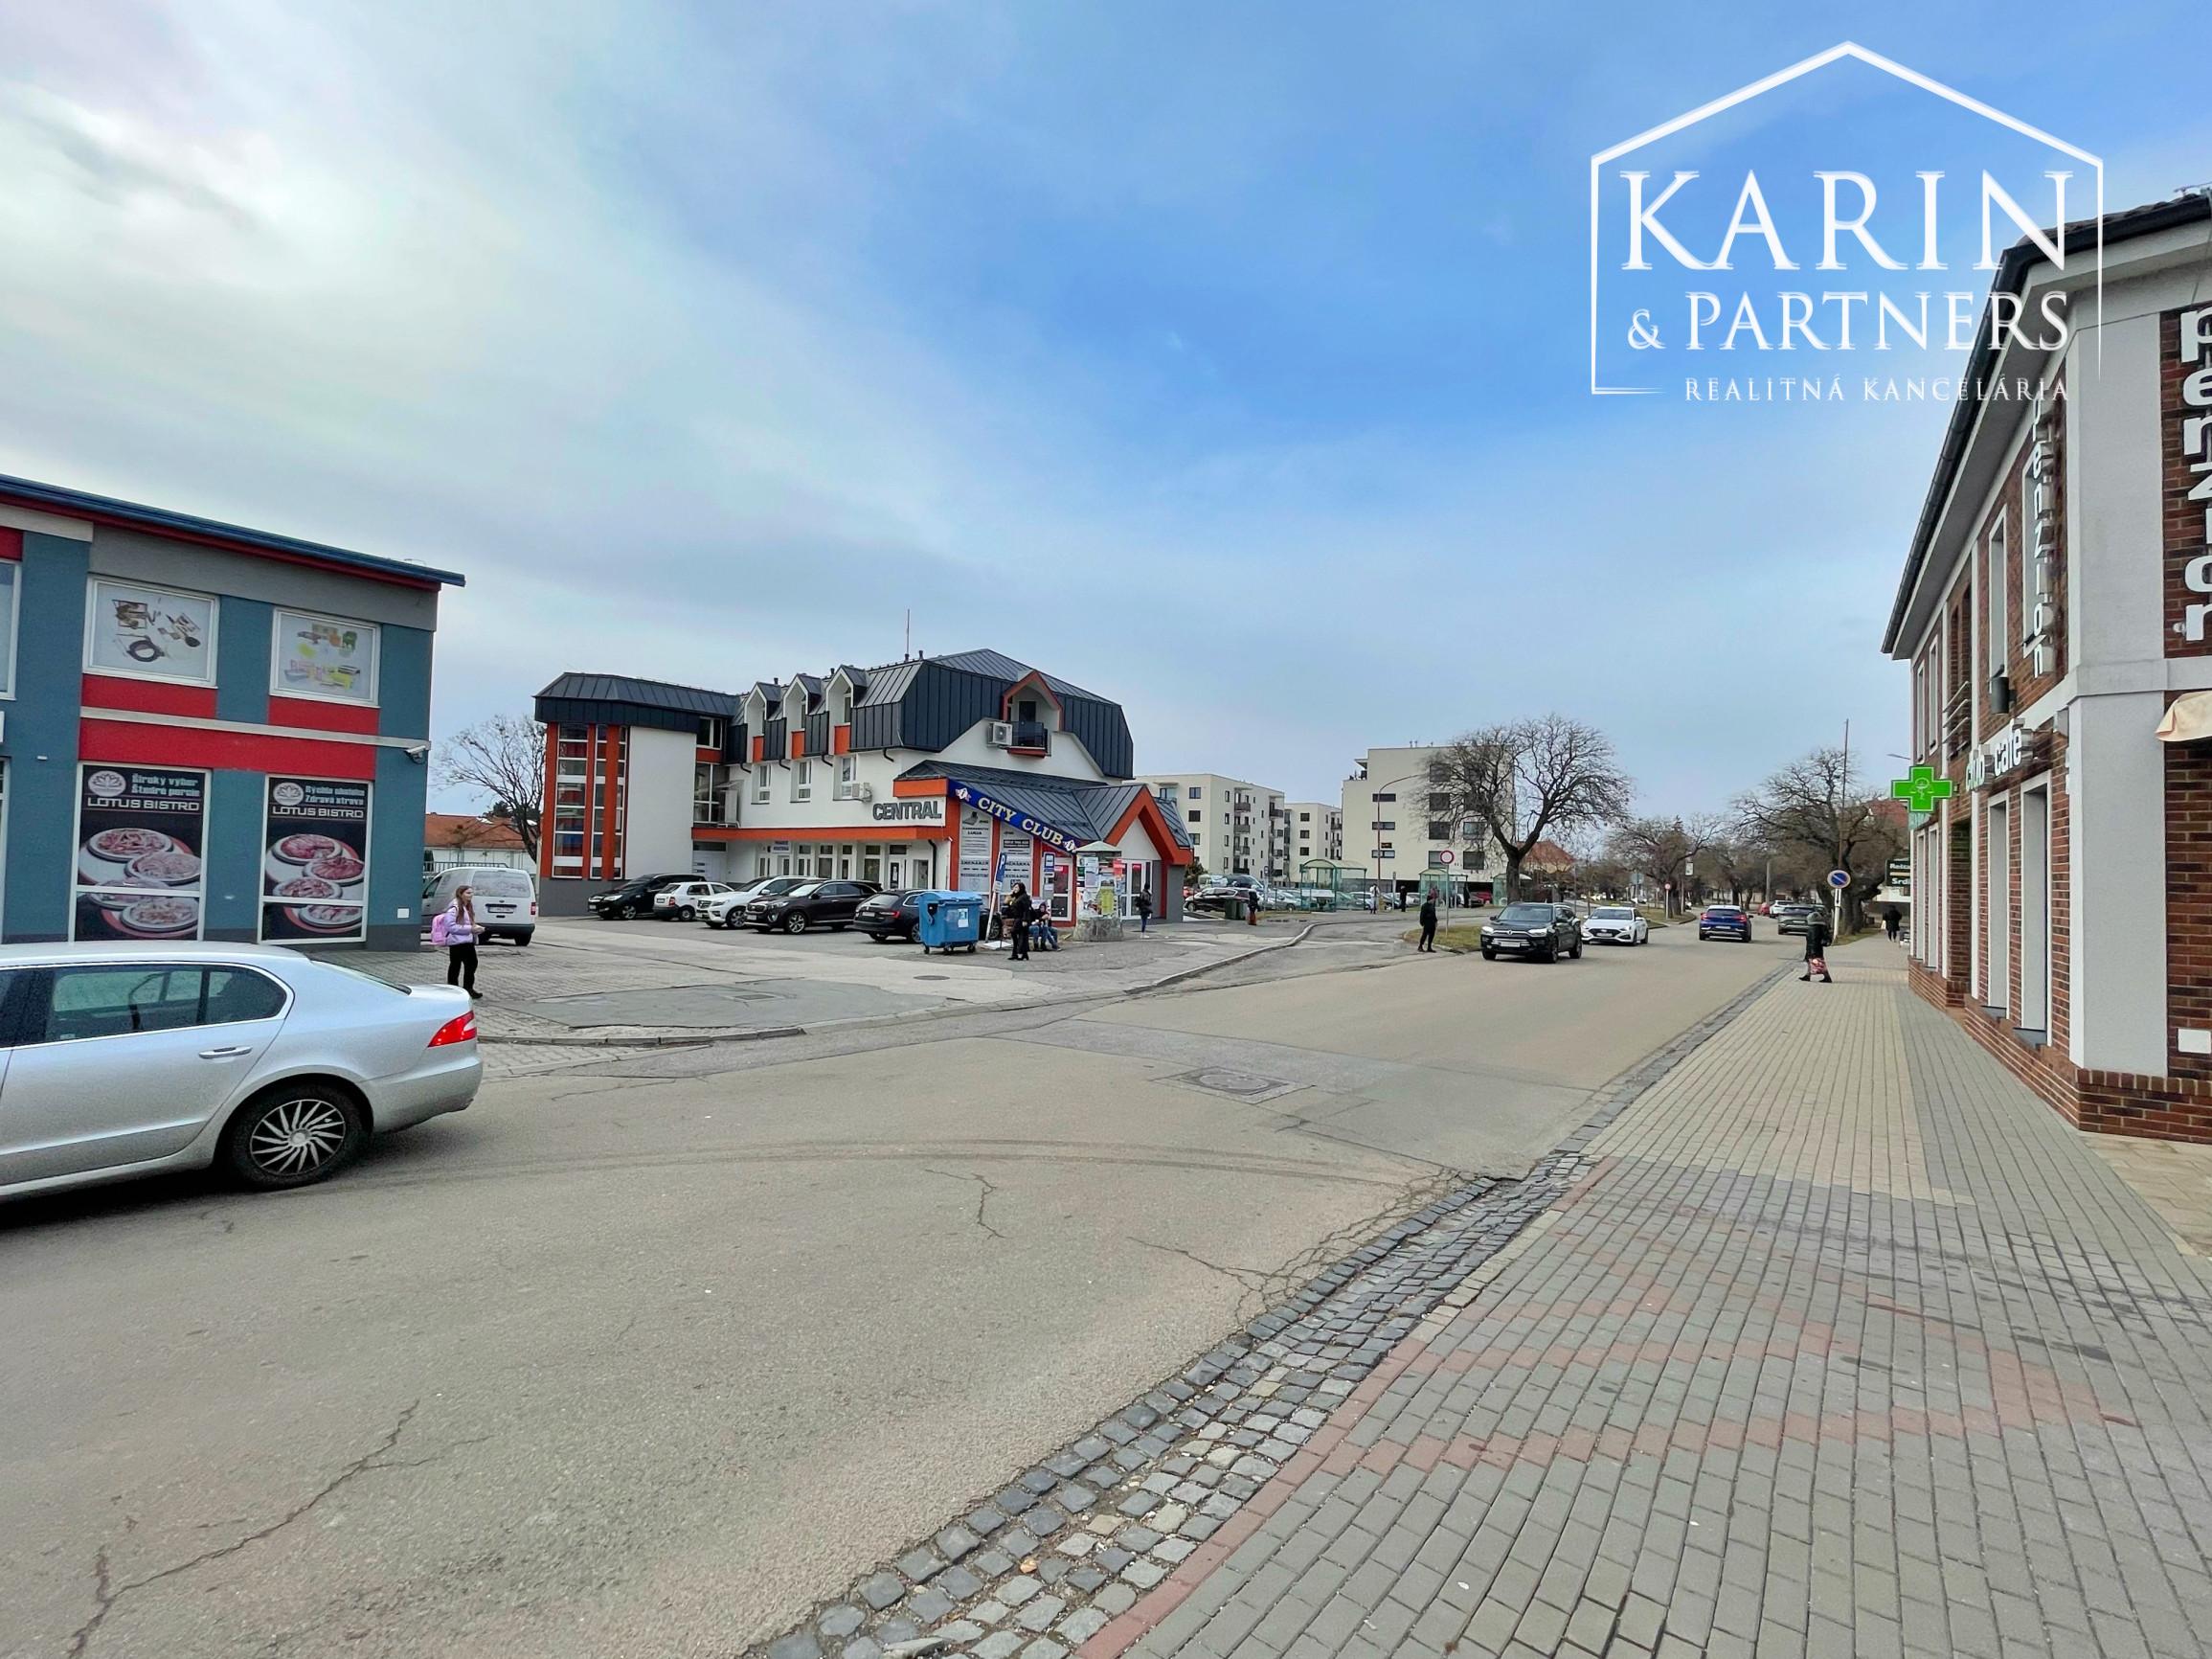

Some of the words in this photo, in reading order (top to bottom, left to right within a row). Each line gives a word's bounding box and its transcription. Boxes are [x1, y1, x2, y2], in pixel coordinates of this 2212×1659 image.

[87, 797, 141, 808] LOTUS
[143, 799, 200, 811] BISTRO
[272, 806, 316, 816] LOTUS
[318, 807, 364, 819] BISTRO
[872, 801, 942, 821] CENTRAL
[978, 797, 1017, 822] CITY
[1022, 818, 1064, 845] CLUB
